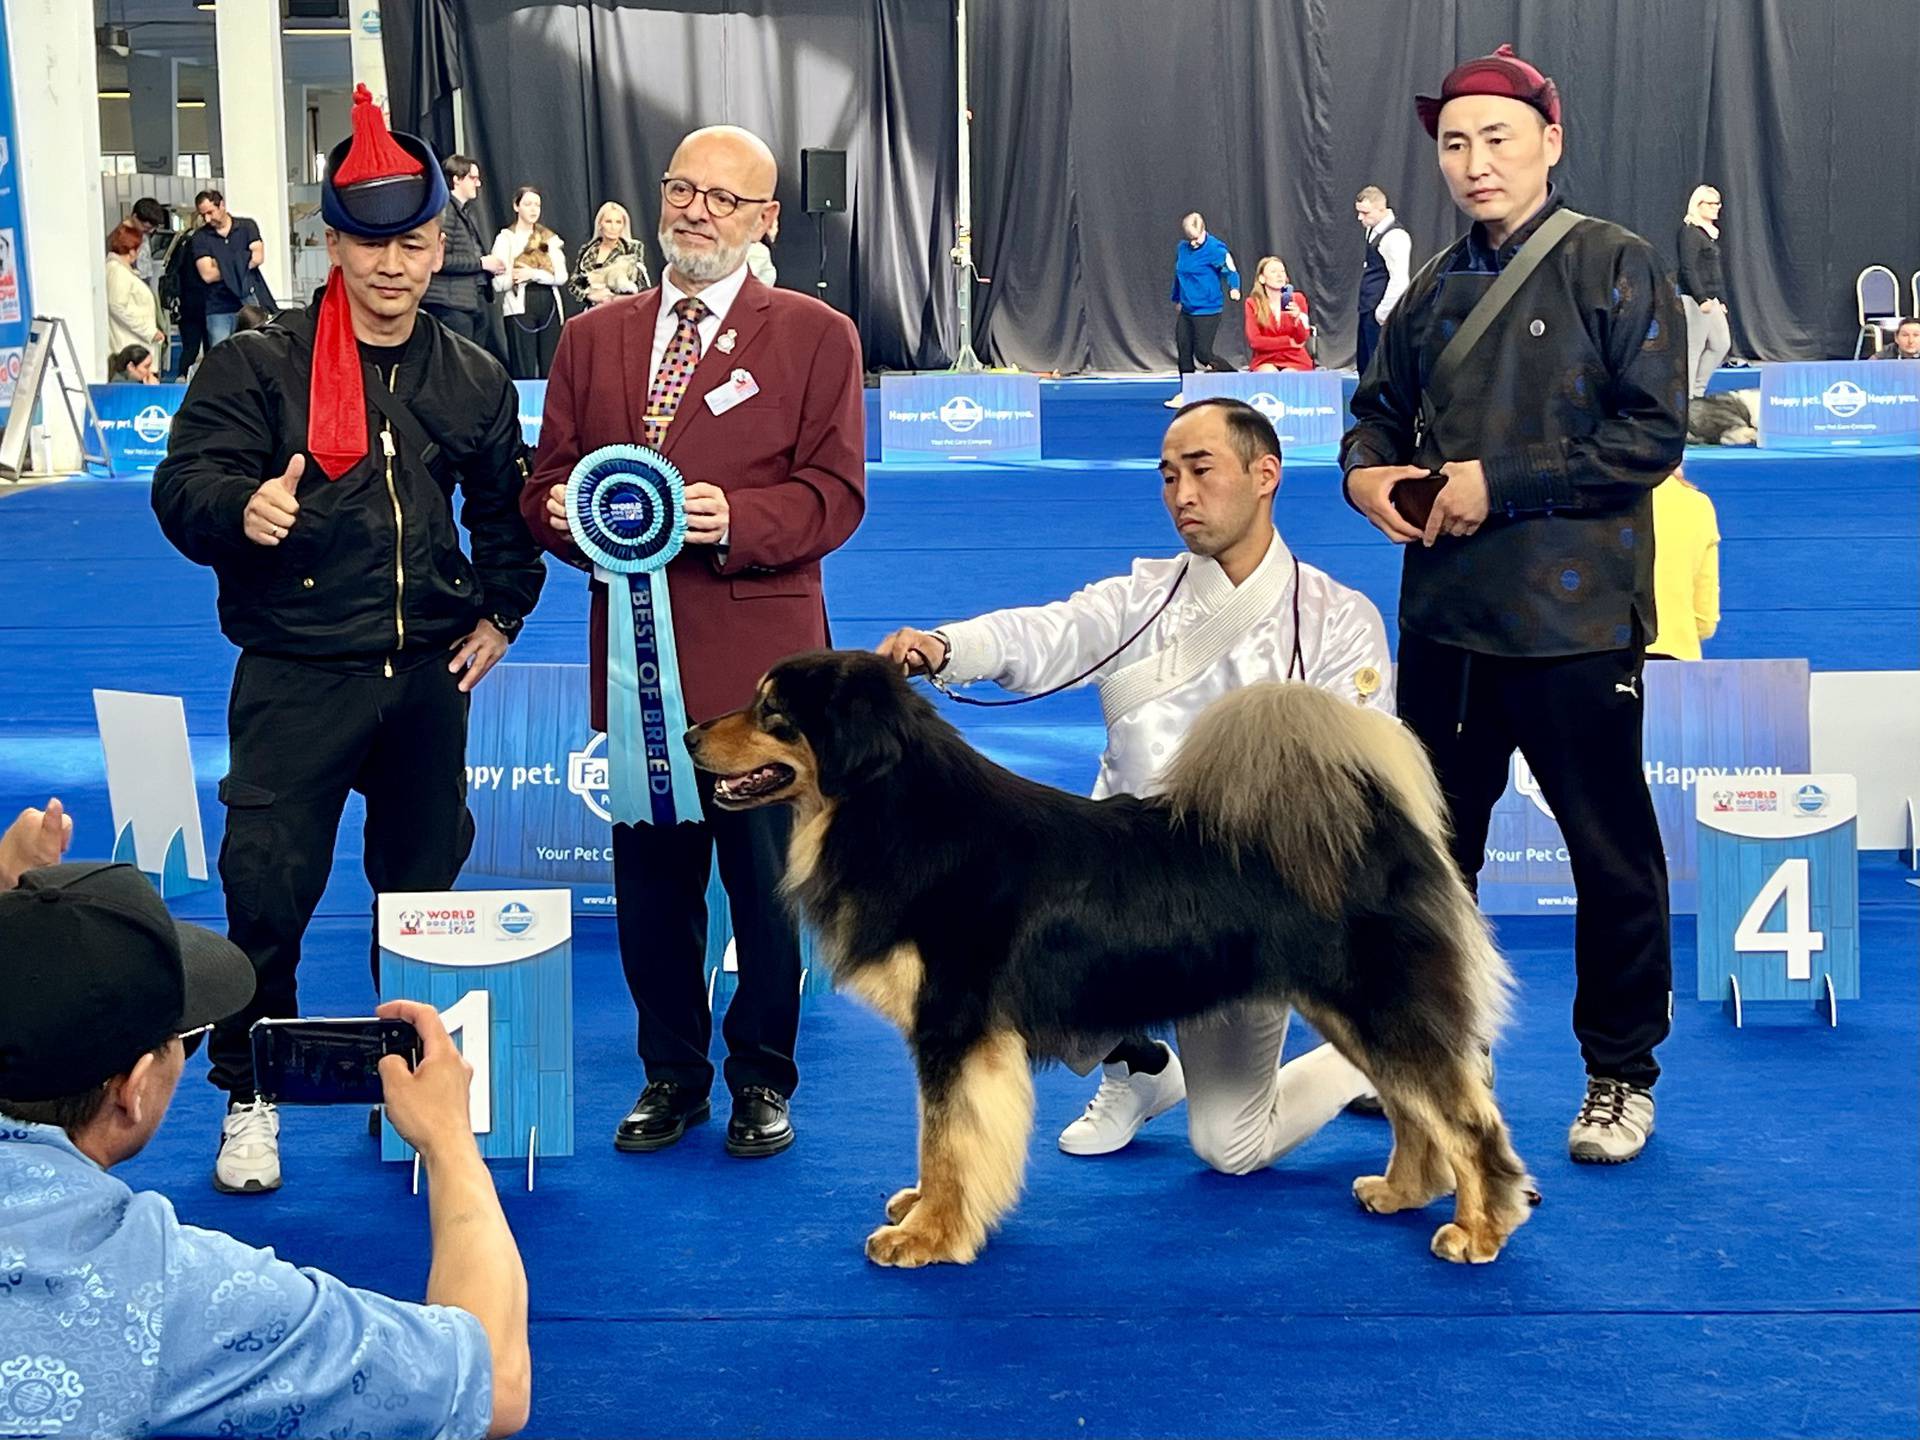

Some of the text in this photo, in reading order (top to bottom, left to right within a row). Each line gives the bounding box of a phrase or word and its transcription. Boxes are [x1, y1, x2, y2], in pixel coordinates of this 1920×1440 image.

[631, 592, 671, 795] BEST OF BREED
[512, 763, 561, 791] pet.
[1736, 791, 1777, 799] WORLD
[537, 847, 613, 861] Your Pet C
[1487, 849, 1523, 862] Your
[1526, 848, 1553, 861] Pet
[427, 910, 475, 919] WORLD
[1734, 859, 1823, 980] 4
[439, 990, 491, 1133] 1
